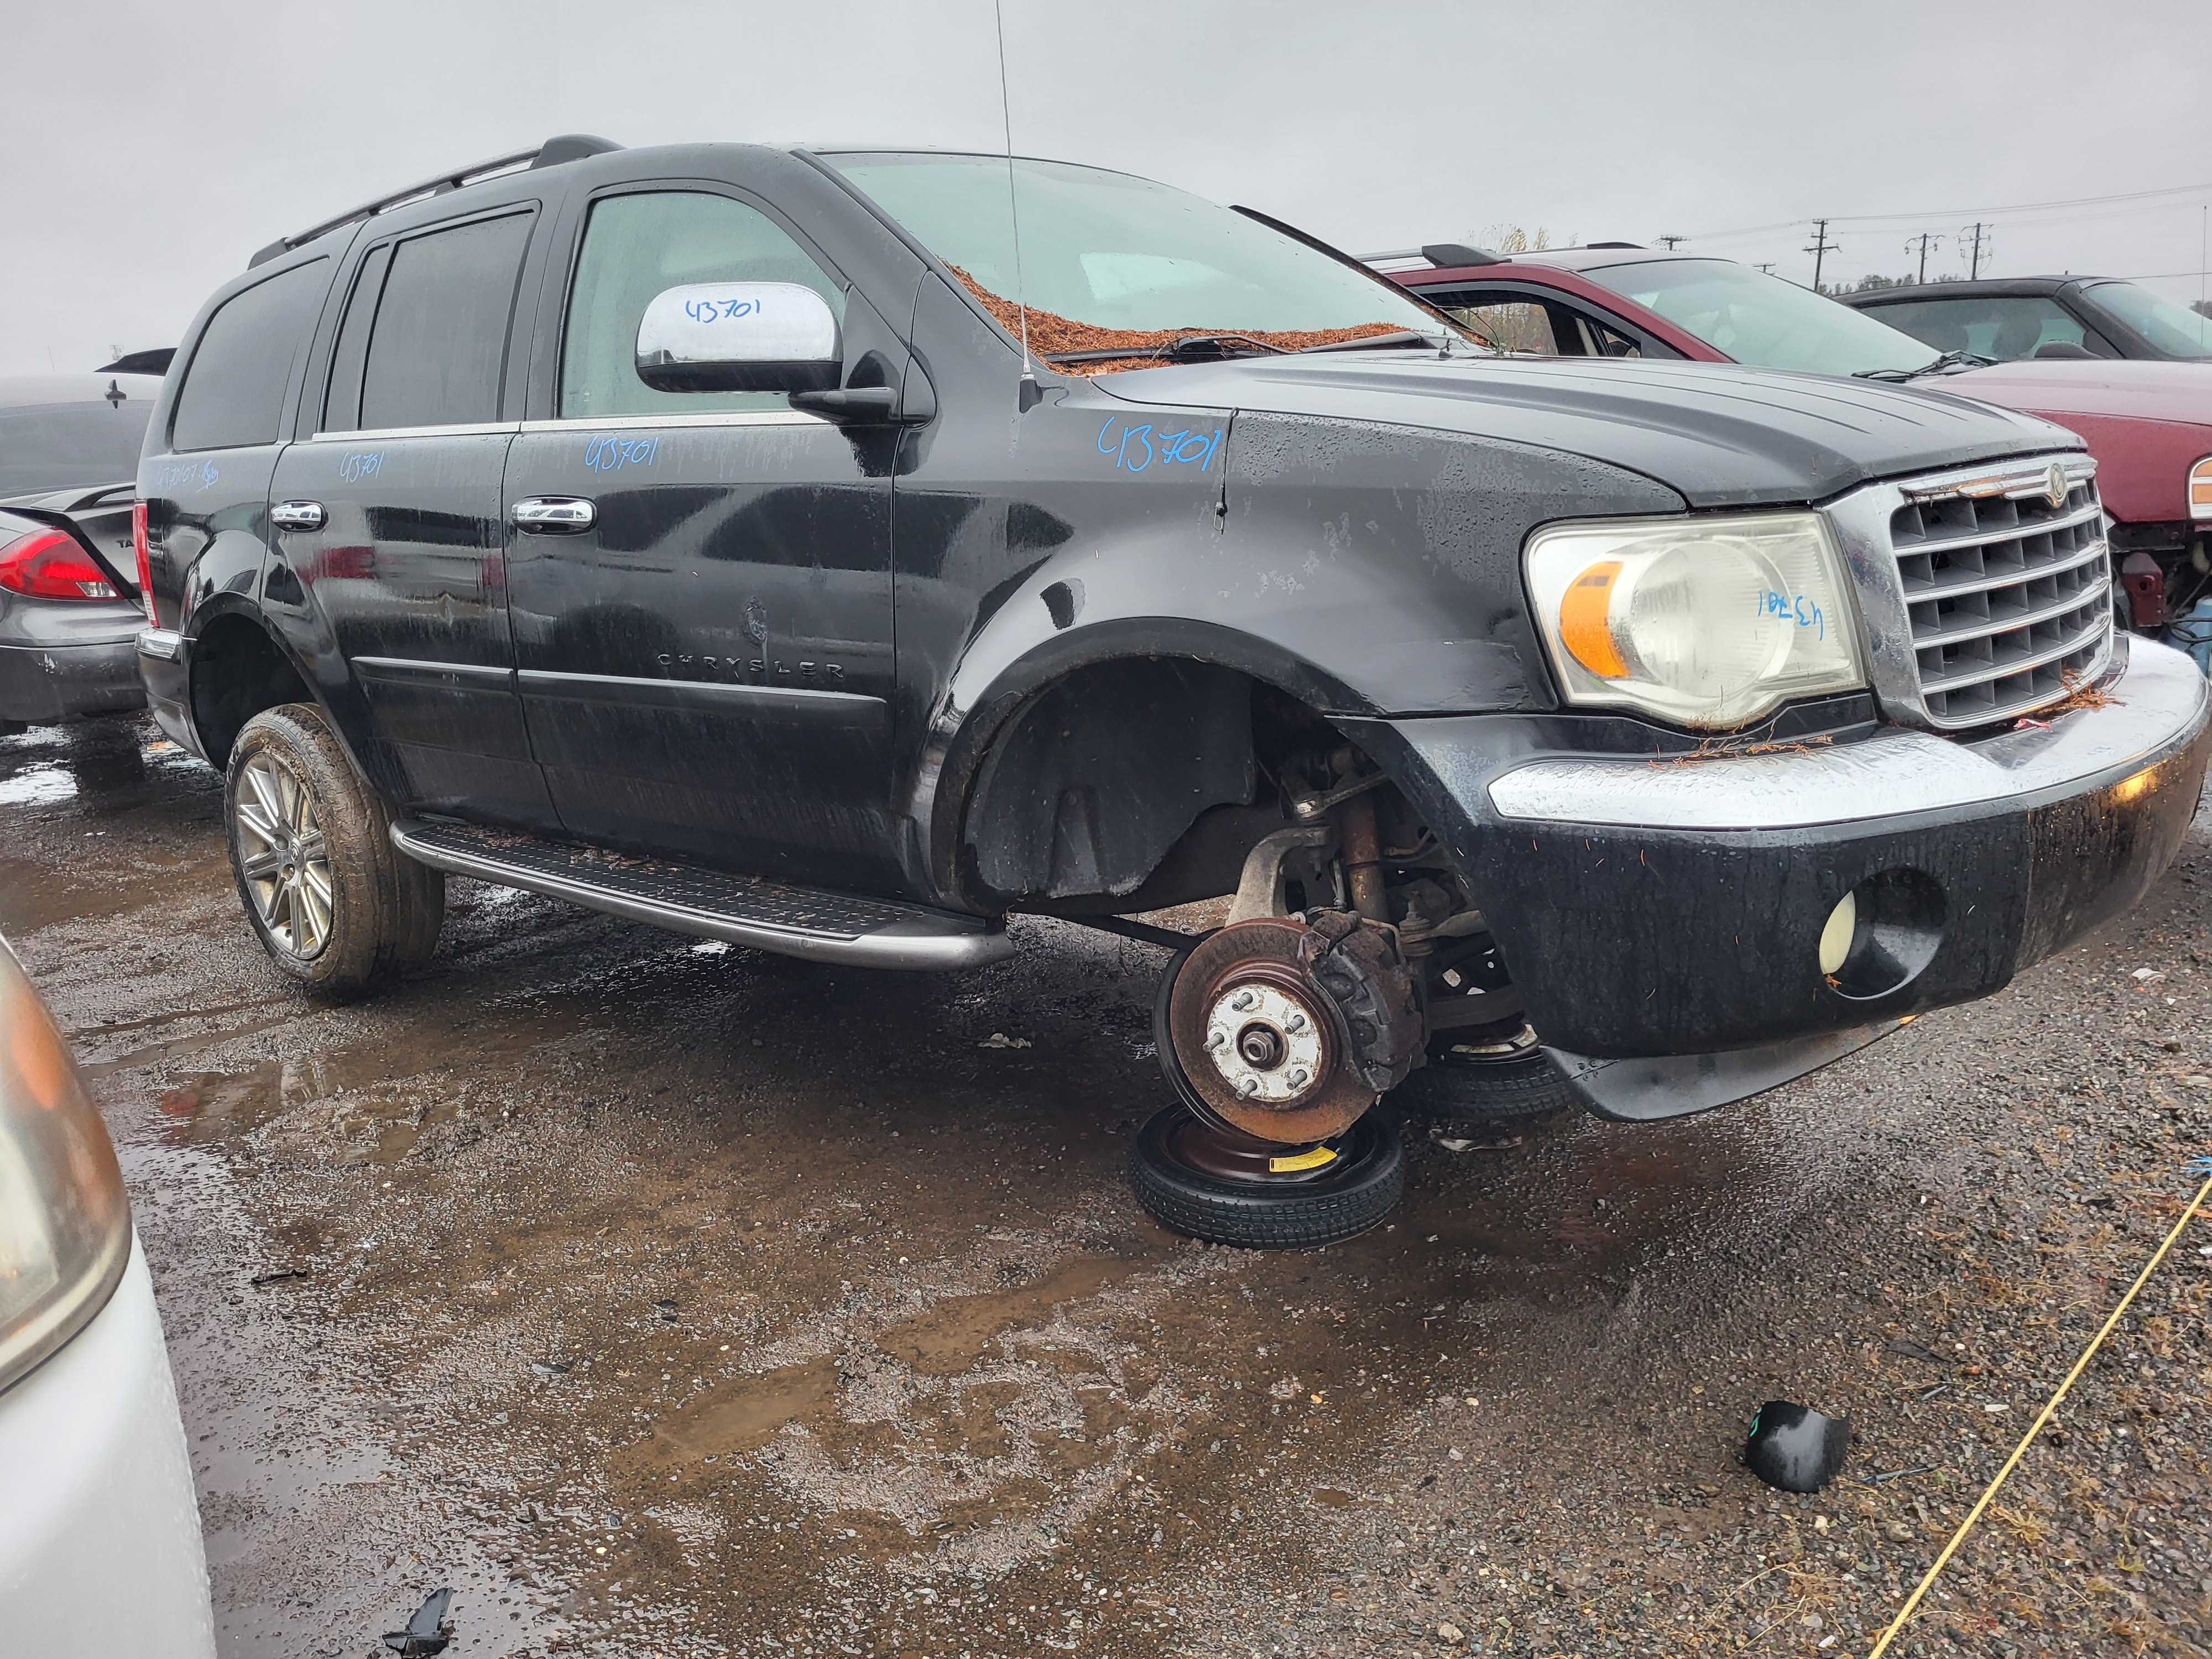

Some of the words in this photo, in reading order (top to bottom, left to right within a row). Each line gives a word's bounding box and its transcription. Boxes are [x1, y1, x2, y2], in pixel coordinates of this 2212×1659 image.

[685, 299, 760, 324] 43701
[585, 437, 658, 473] 43701
[1097, 416, 1221, 472] 43701
[340, 451, 384, 483] 43701
[656, 653, 844, 679] CHRYSLER
